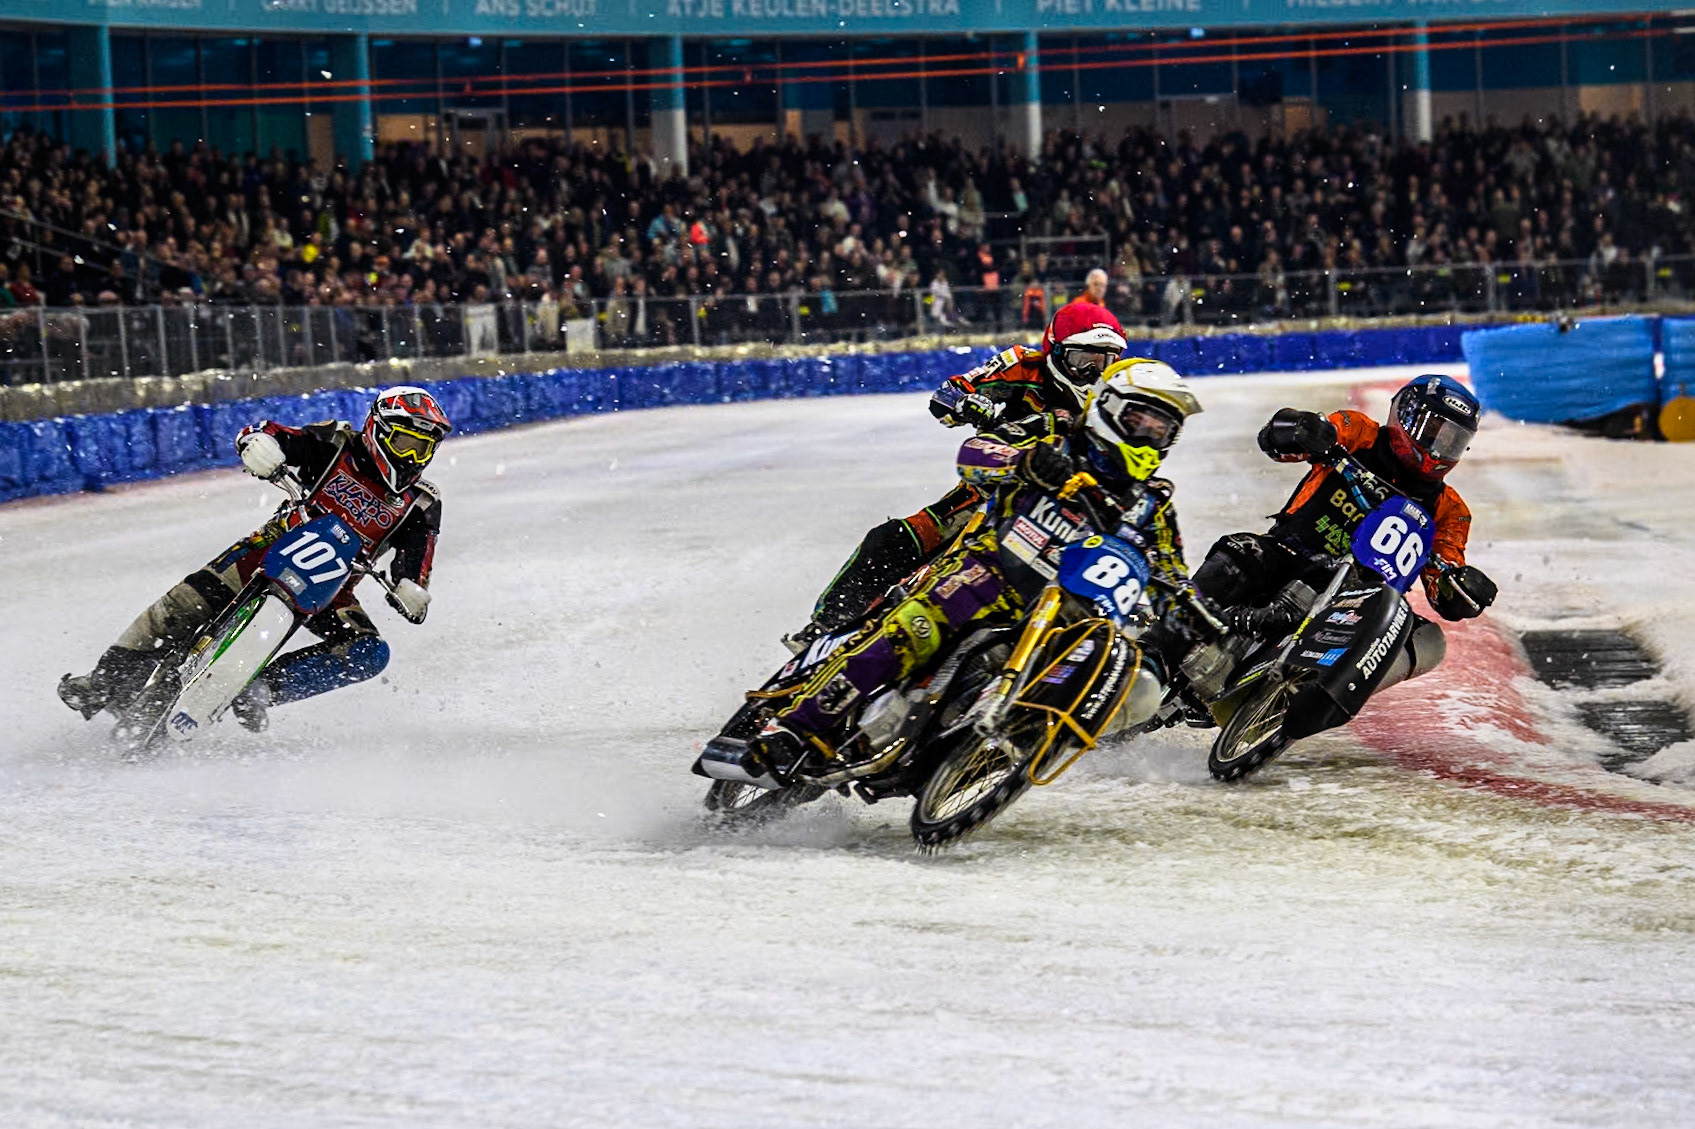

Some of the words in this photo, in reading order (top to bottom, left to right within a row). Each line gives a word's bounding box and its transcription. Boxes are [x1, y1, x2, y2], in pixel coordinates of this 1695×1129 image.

[475, 0, 521, 17] ANS
[666, 0, 724, 18] ATJE
[1036, 0, 1094, 14] PIET
[1105, 0, 1203, 12] KLEINE
[1443, 396, 1471, 416] HJC
[279, 530, 349, 585] 107
[1370, 515, 1424, 577] 66
[1379, 557, 1398, 580] FIM
[1082, 555, 1141, 615] 88
[1361, 605, 1408, 680] AUTOTARVIKE
